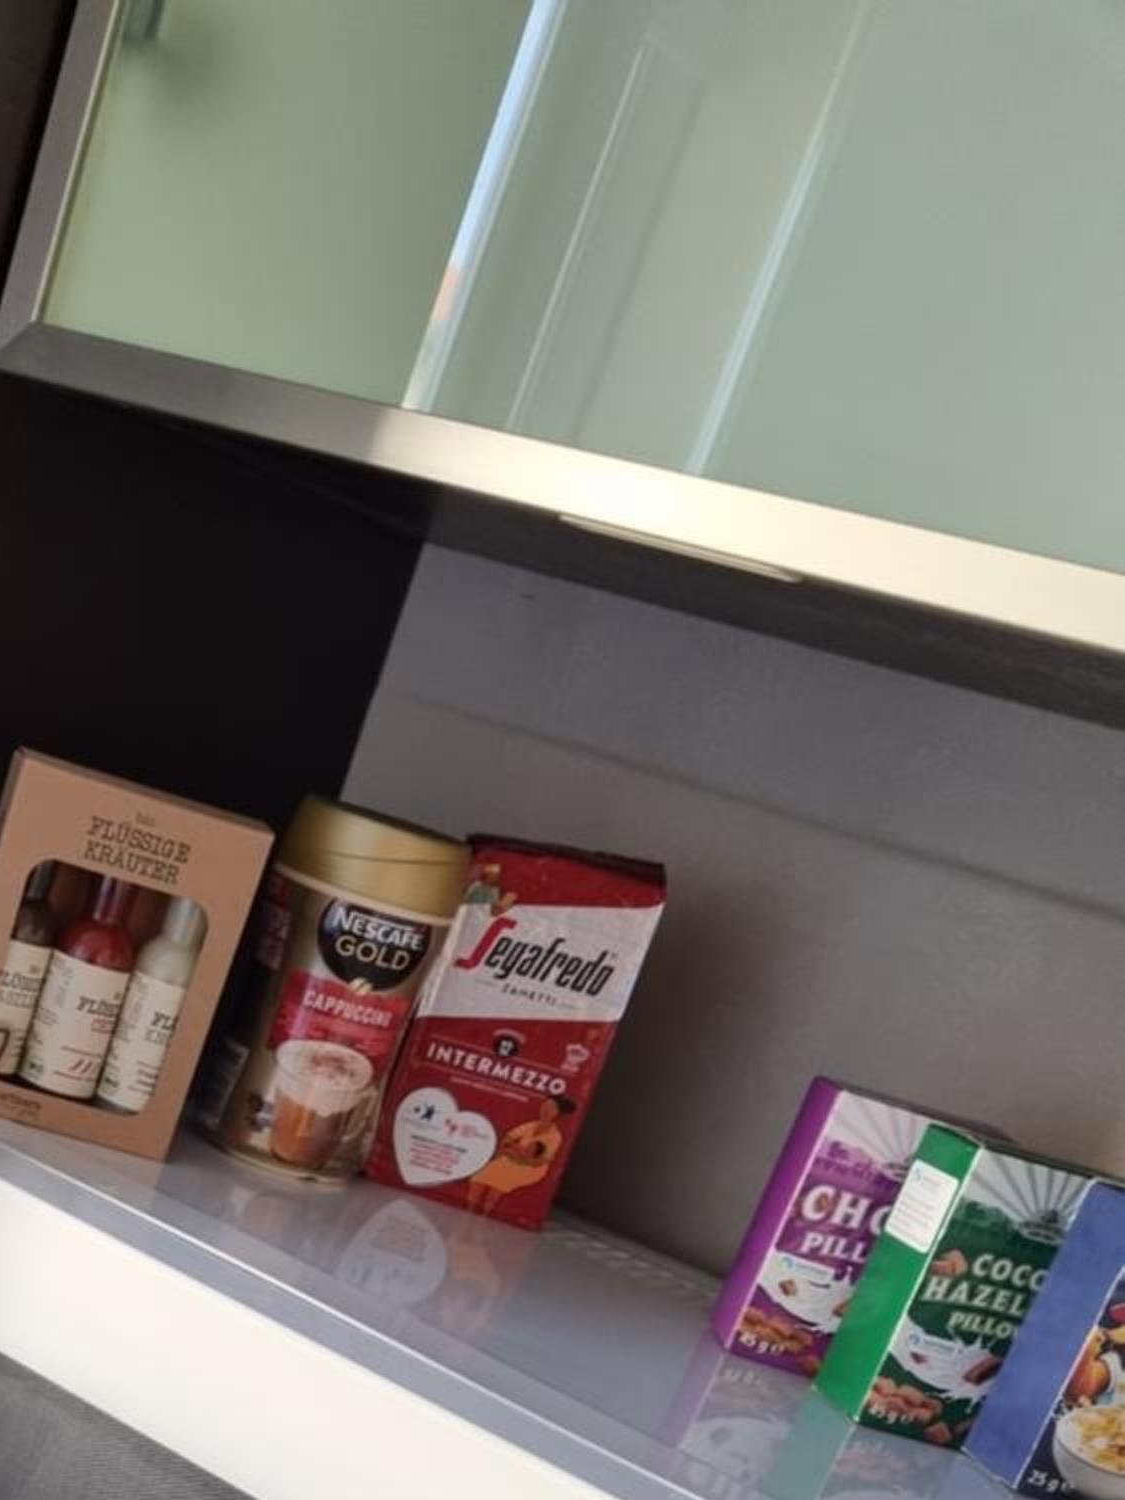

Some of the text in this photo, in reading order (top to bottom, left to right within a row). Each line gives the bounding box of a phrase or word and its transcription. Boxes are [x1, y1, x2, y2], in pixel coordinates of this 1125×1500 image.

[334, 935, 411, 971] GOLD
[455, 917, 615, 997] Segafredo
[427, 1042, 567, 1096] INTERMEZZO
[922, 1276, 1025, 1316] HAZEL
